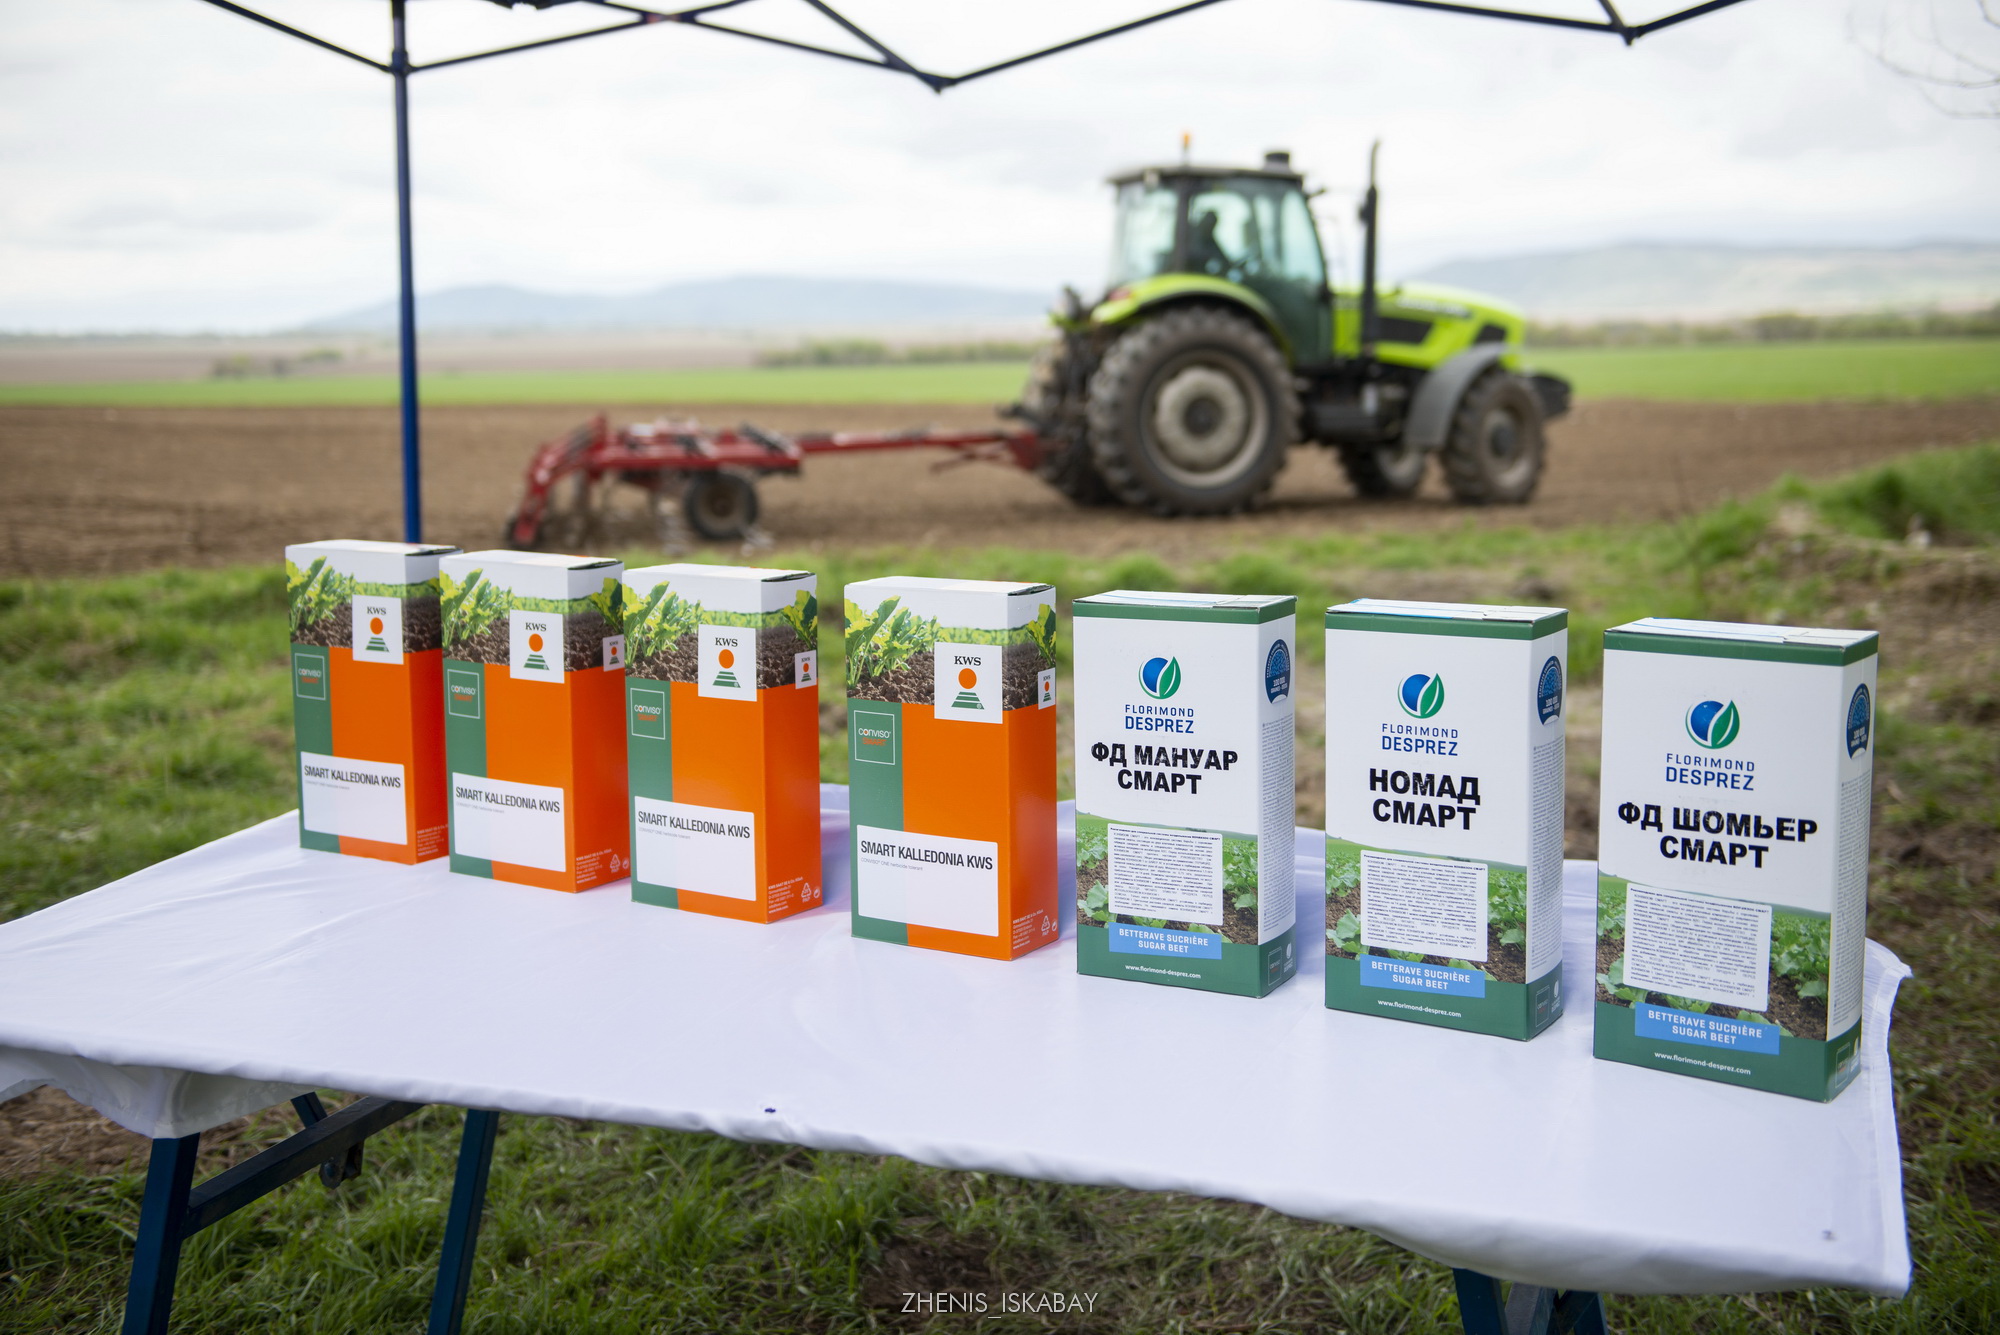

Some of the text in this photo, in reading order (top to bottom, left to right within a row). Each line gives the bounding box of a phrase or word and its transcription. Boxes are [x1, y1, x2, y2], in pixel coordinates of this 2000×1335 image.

[366, 606, 387, 616] KWS
[525, 622, 547, 632] KWS
[715, 636, 739, 647] KWS
[954, 655, 982, 666] KWS
[1125, 704, 1194, 717] FLORIMOND
[1125, 716, 1194, 734] DESPREZ
[1382, 723, 1458, 739] FLORIMOND
[1382, 735, 1458, 756] DESPREZ
[1091, 742, 1238, 771] ФД МАНУАР
[1666, 753, 1755, 772] FLORIMOND
[304, 765, 329, 779] SMART
[331, 769, 380, 786] KALLEDONIA
[381, 776, 401, 788] KWS
[1117, 769, 1202, 794] СМАРТ
[1369, 768, 1481, 806] НОМАД
[1665, 766, 1754, 791] DESPREZ
[455, 786, 483, 801] SMART
[484, 791, 537, 810] KALLEDONIA
[539, 799, 560, 813] KWS
[638, 811, 668, 827] SMART
[669, 816, 726, 836] KALLEDONIA
[727, 824, 751, 839] KWS
[1372, 798, 1476, 831] СМАРТ
[1617, 801, 1818, 843] ФД ШОМЬЕР
[861, 840, 993, 870] SMART KALLEDONIA KWS
[1659, 835, 1769, 869] СМАРТ
[1119, 928, 1209, 947] BETTERAVE SUCRIÈRE
[1138, 940, 1189, 954] SUGAR BEET
[1124, 963, 1201, 979] www.florimond-desprez.com
[1371, 960, 1471, 984] BETTERAVE SUCRIÈRE
[1392, 974, 1449, 991] SUGAR BEET
[1377, 999, 1462, 1018] www.florimond-desprez.com
[1648, 1010, 1763, 1039] BETTERAVE SUCRIÈRE
[1672, 1025, 1737, 1046] SUGAR BEET
[1654, 1052, 1751, 1076] www.florimond-desprez.com
